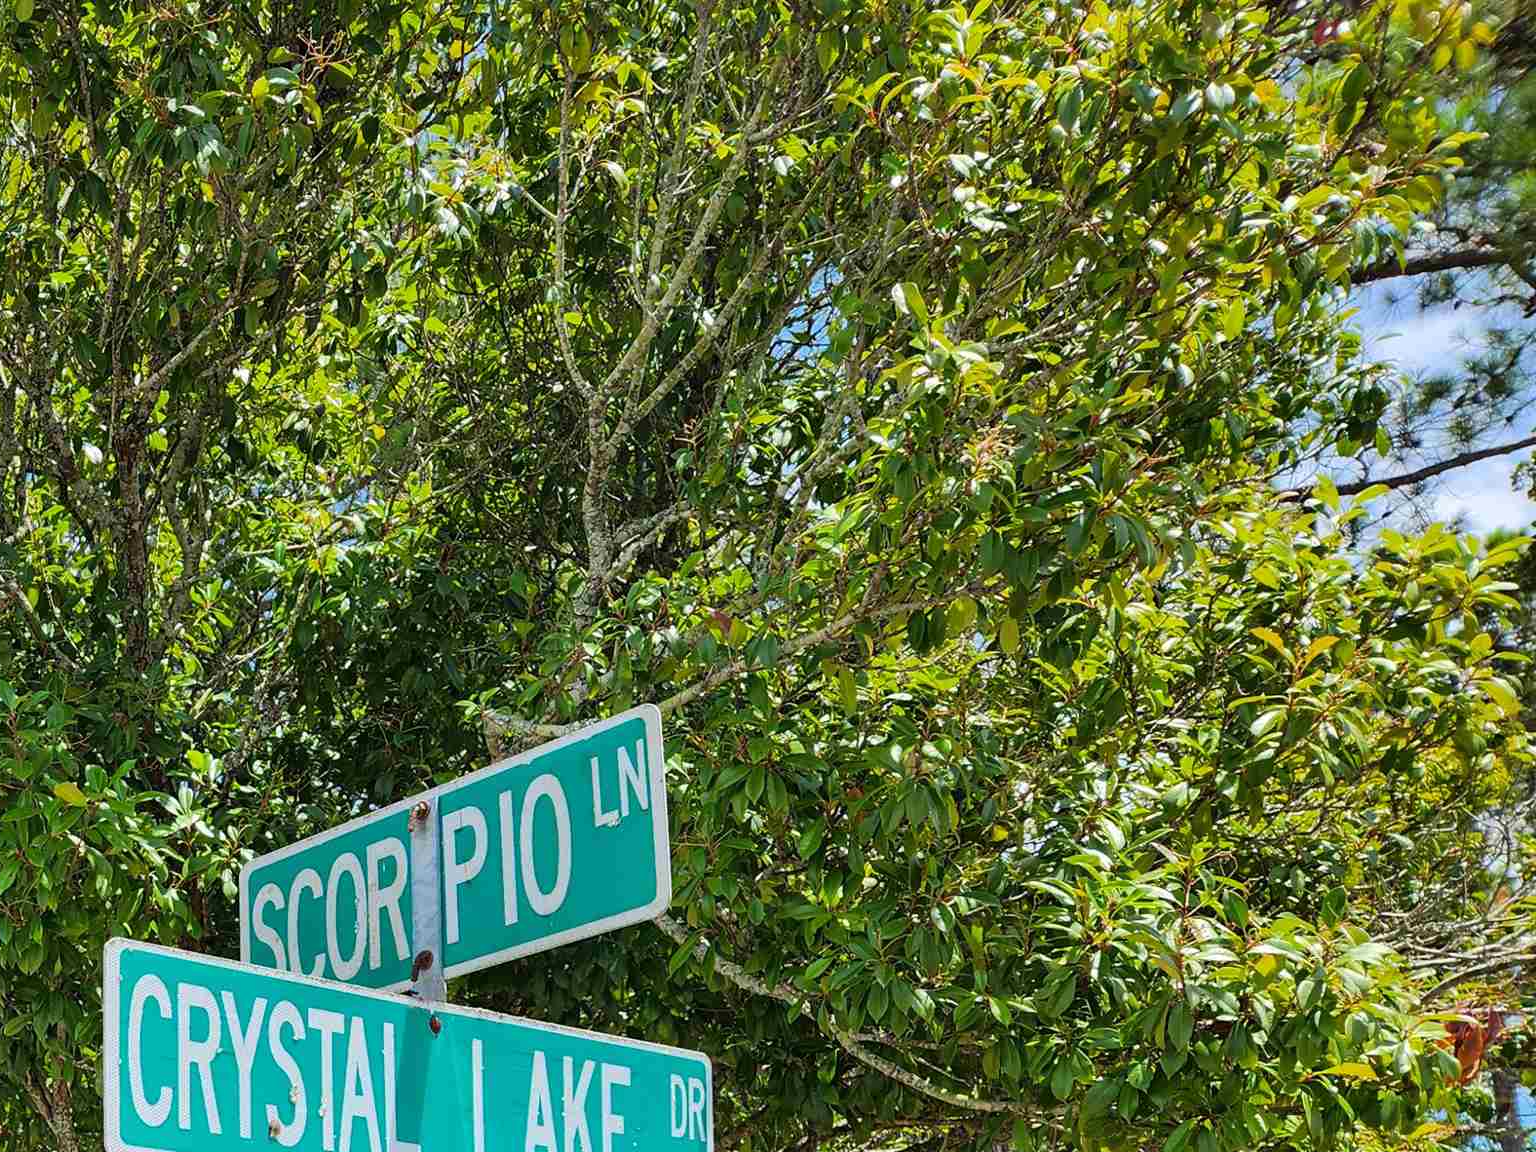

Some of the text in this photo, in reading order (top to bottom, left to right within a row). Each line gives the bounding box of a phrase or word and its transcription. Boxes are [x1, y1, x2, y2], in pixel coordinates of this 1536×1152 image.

[252, 738, 650, 981] SCORPIO LN
[669, 1072, 707, 1143] DR
